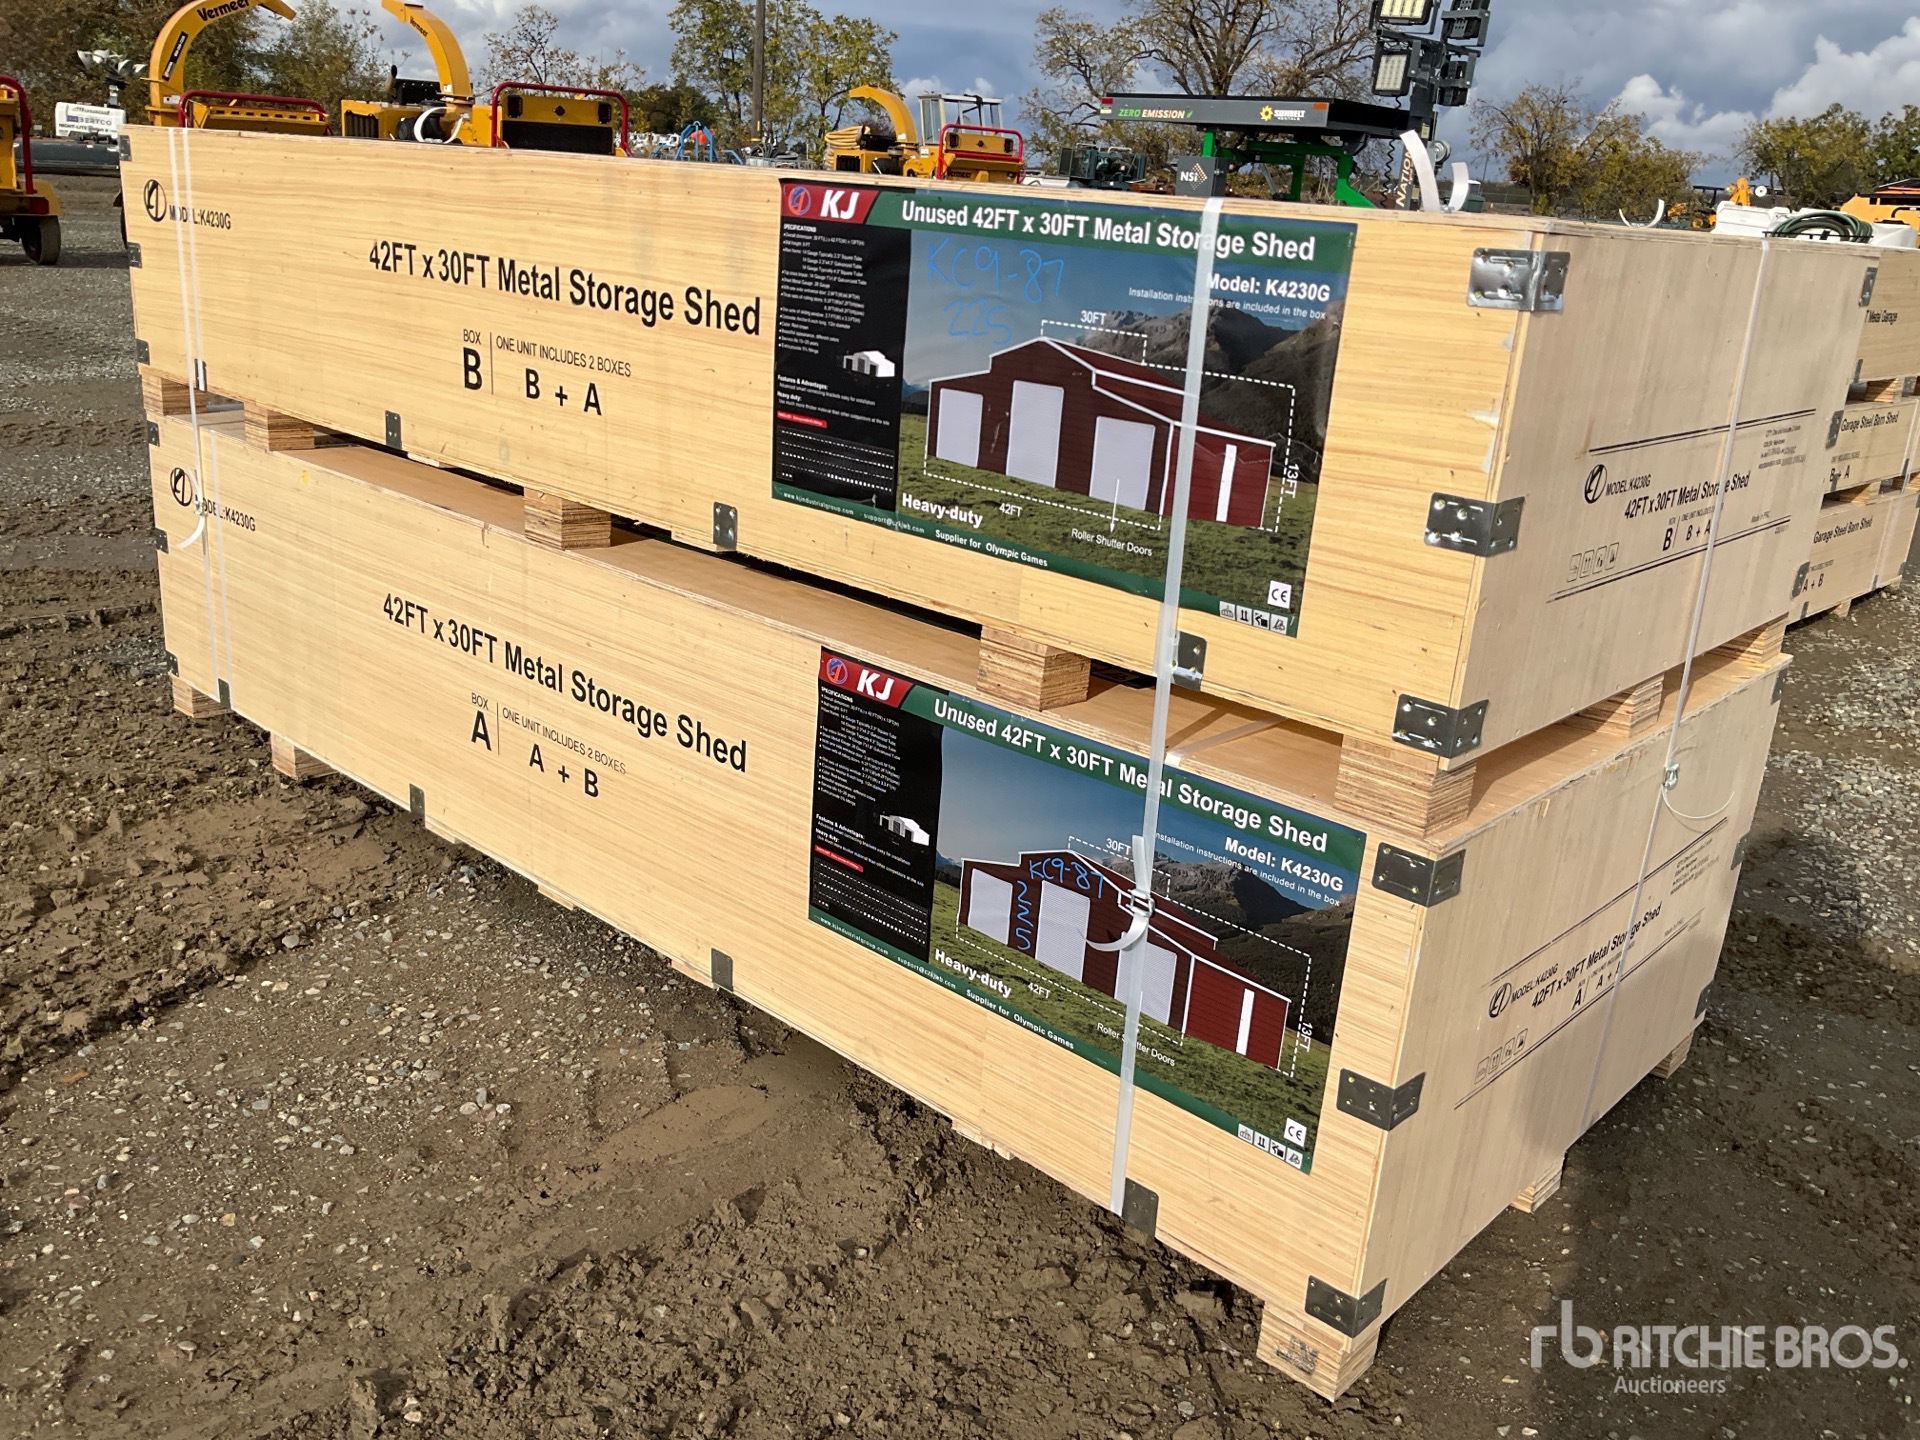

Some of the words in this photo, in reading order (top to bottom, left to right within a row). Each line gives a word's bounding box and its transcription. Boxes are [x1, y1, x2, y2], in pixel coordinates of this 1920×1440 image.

[197, 0, 250, 21] Vermeer
[1118, 108, 1141, 118] ZERO
[1142, 109, 1185, 119] EMISSION
[820, 189, 860, 220] KJ
[902, 199, 968, 228] Unused
[972, 207, 1019, 233] 42FT
[1022, 216, 1035, 234] x
[1039, 212, 1090, 238] 30FT
[1094, 218, 1150, 245] Metal
[1252, 231, 1315, 261] Shed
[369, 240, 417, 276] 42FT
[422, 254, 434, 280] x
[438, 249, 490, 289] 30FT
[498, 257, 561, 302] Metal
[569, 269, 675, 328] Storage
[684, 286, 761, 336] Shed
[1129, 287, 1173, 301] Installation
[1225, 300, 1241, 310] are
[1243, 300, 1281, 315] included
[1282, 304, 1291, 316] in
[1293, 306, 1308, 318] the
[1310, 308, 1327, 320] box
[1207, 272, 1261, 294] Model:
[1265, 278, 1330, 303] K4230G
[943, 298, 1013, 346] 225
[1080, 310, 1107, 326] 30FT
[1869, 310, 1881, 323] Metal
[1881, 310, 1898, 326] Garage
[463, 329, 482, 346] BOX
[463, 346, 483, 391] B
[496, 335, 515, 354] ONE
[516, 339, 538, 358] UNIT
[539, 344, 587, 369] INCLUDES
[588, 355, 595, 370] 2
[597, 357, 632, 378] BOXES
[525, 367, 541, 400] B
[584, 382, 602, 416] A
[1840, 417, 1859, 433] Garage
[1859, 415, 1873, 430] Steel
[1873, 413, 1886, 427] Barn
[1886, 410, 1900, 424] Shed
[1284, 463, 1300, 499] 13FT
[1624, 496, 1649, 519] 42FT
[1648, 499, 1655, 514] x
[1655, 489, 1678, 512] 30FT
[1677, 482, 1701, 506] Metal
[1730, 470, 1751, 491] Shed
[901, 492, 983, 528] Heavy-duty
[999, 503, 1023, 518] 42FT
[1071, 528, 1095, 545] Roller
[1095, 534, 1126, 551] Shutter
[1127, 541, 1153, 557] Doors
[1662, 527, 1674, 552] B
[1686, 524, 1693, 541] B
[1813, 530, 1834, 544] Garage
[1833, 523, 1849, 538] Steel
[1848, 521, 1860, 534] Barn
[1859, 515, 1873, 530] Shed
[935, 529, 968, 546] Supplier
[969, 537, 982, 550] for
[985, 542, 1019, 562] Olympic
[1020, 552, 1048, 567] Games
[1802, 578, 1809, 593] A
[1818, 573, 1825, 588] B
[383, 593, 429, 634] 42FT
[433, 618, 445, 643] x
[448, 618, 498, 664] 30FT
[505, 640, 564, 694] Metal
[571, 670, 668, 739] Storage
[676, 713, 748, 774] Shed
[856, 668, 895, 701] KJ
[471, 691, 489, 711] BOX
[470, 710, 492, 752] A
[502, 706, 520, 726] ONE
[521, 712, 541, 734] UNIT
[542, 725, 586, 760] INCLUDES
[587, 746, 594, 760] 2
[594, 749, 627, 775] BOXES
[528, 743, 545, 773] A
[584, 767, 599, 799] B
[934, 698, 997, 738] Unused
[1001, 724, 1046, 754] 42FT
[1049, 743, 1061, 761] x
[1066, 746, 1114, 777] 30FT
[1178, 783, 1261, 830] Storage
[1268, 814, 1328, 854] Shed
[1106, 838, 1132, 856] 30FT
[1029, 857, 1106, 899] KC9-87
[1155, 832, 1195, 852] nstallation
[1196, 847, 1242, 870] instructions
[1244, 865, 1258, 876] are
[1260, 869, 1296, 891] included
[1298, 881, 1307, 893] in
[1307, 884, 1323, 899] the
[1323, 890, 1341, 907] box
[1224, 836, 1276, 869] Model:
[1280, 855, 1344, 893] K4230G
[1532, 979, 1558, 1008] 42FT
[1556, 977, 1564, 992] x
[1563, 957, 1587, 987] 30FT
[1586, 940, 1611, 970] Metal
[1641, 900, 1663, 928] Shed
[935, 948, 1013, 999] Heavy-duty
[1027, 981, 1052, 1000] 42FT
[1595, 975, 1604, 990] A
[1571, 989, 1582, 1011] A
[966, 988, 997, 1013] Supplier
[998, 1003, 1011, 1017] for
[1013, 1013, 1046, 1036] Olympic
[1046, 1028, 1075, 1050] Games
[1097, 1022, 1120, 1040] Roller
[1151, 1048, 1175, 1067] Doors
[1300, 1021, 1313, 1054] 13FT
